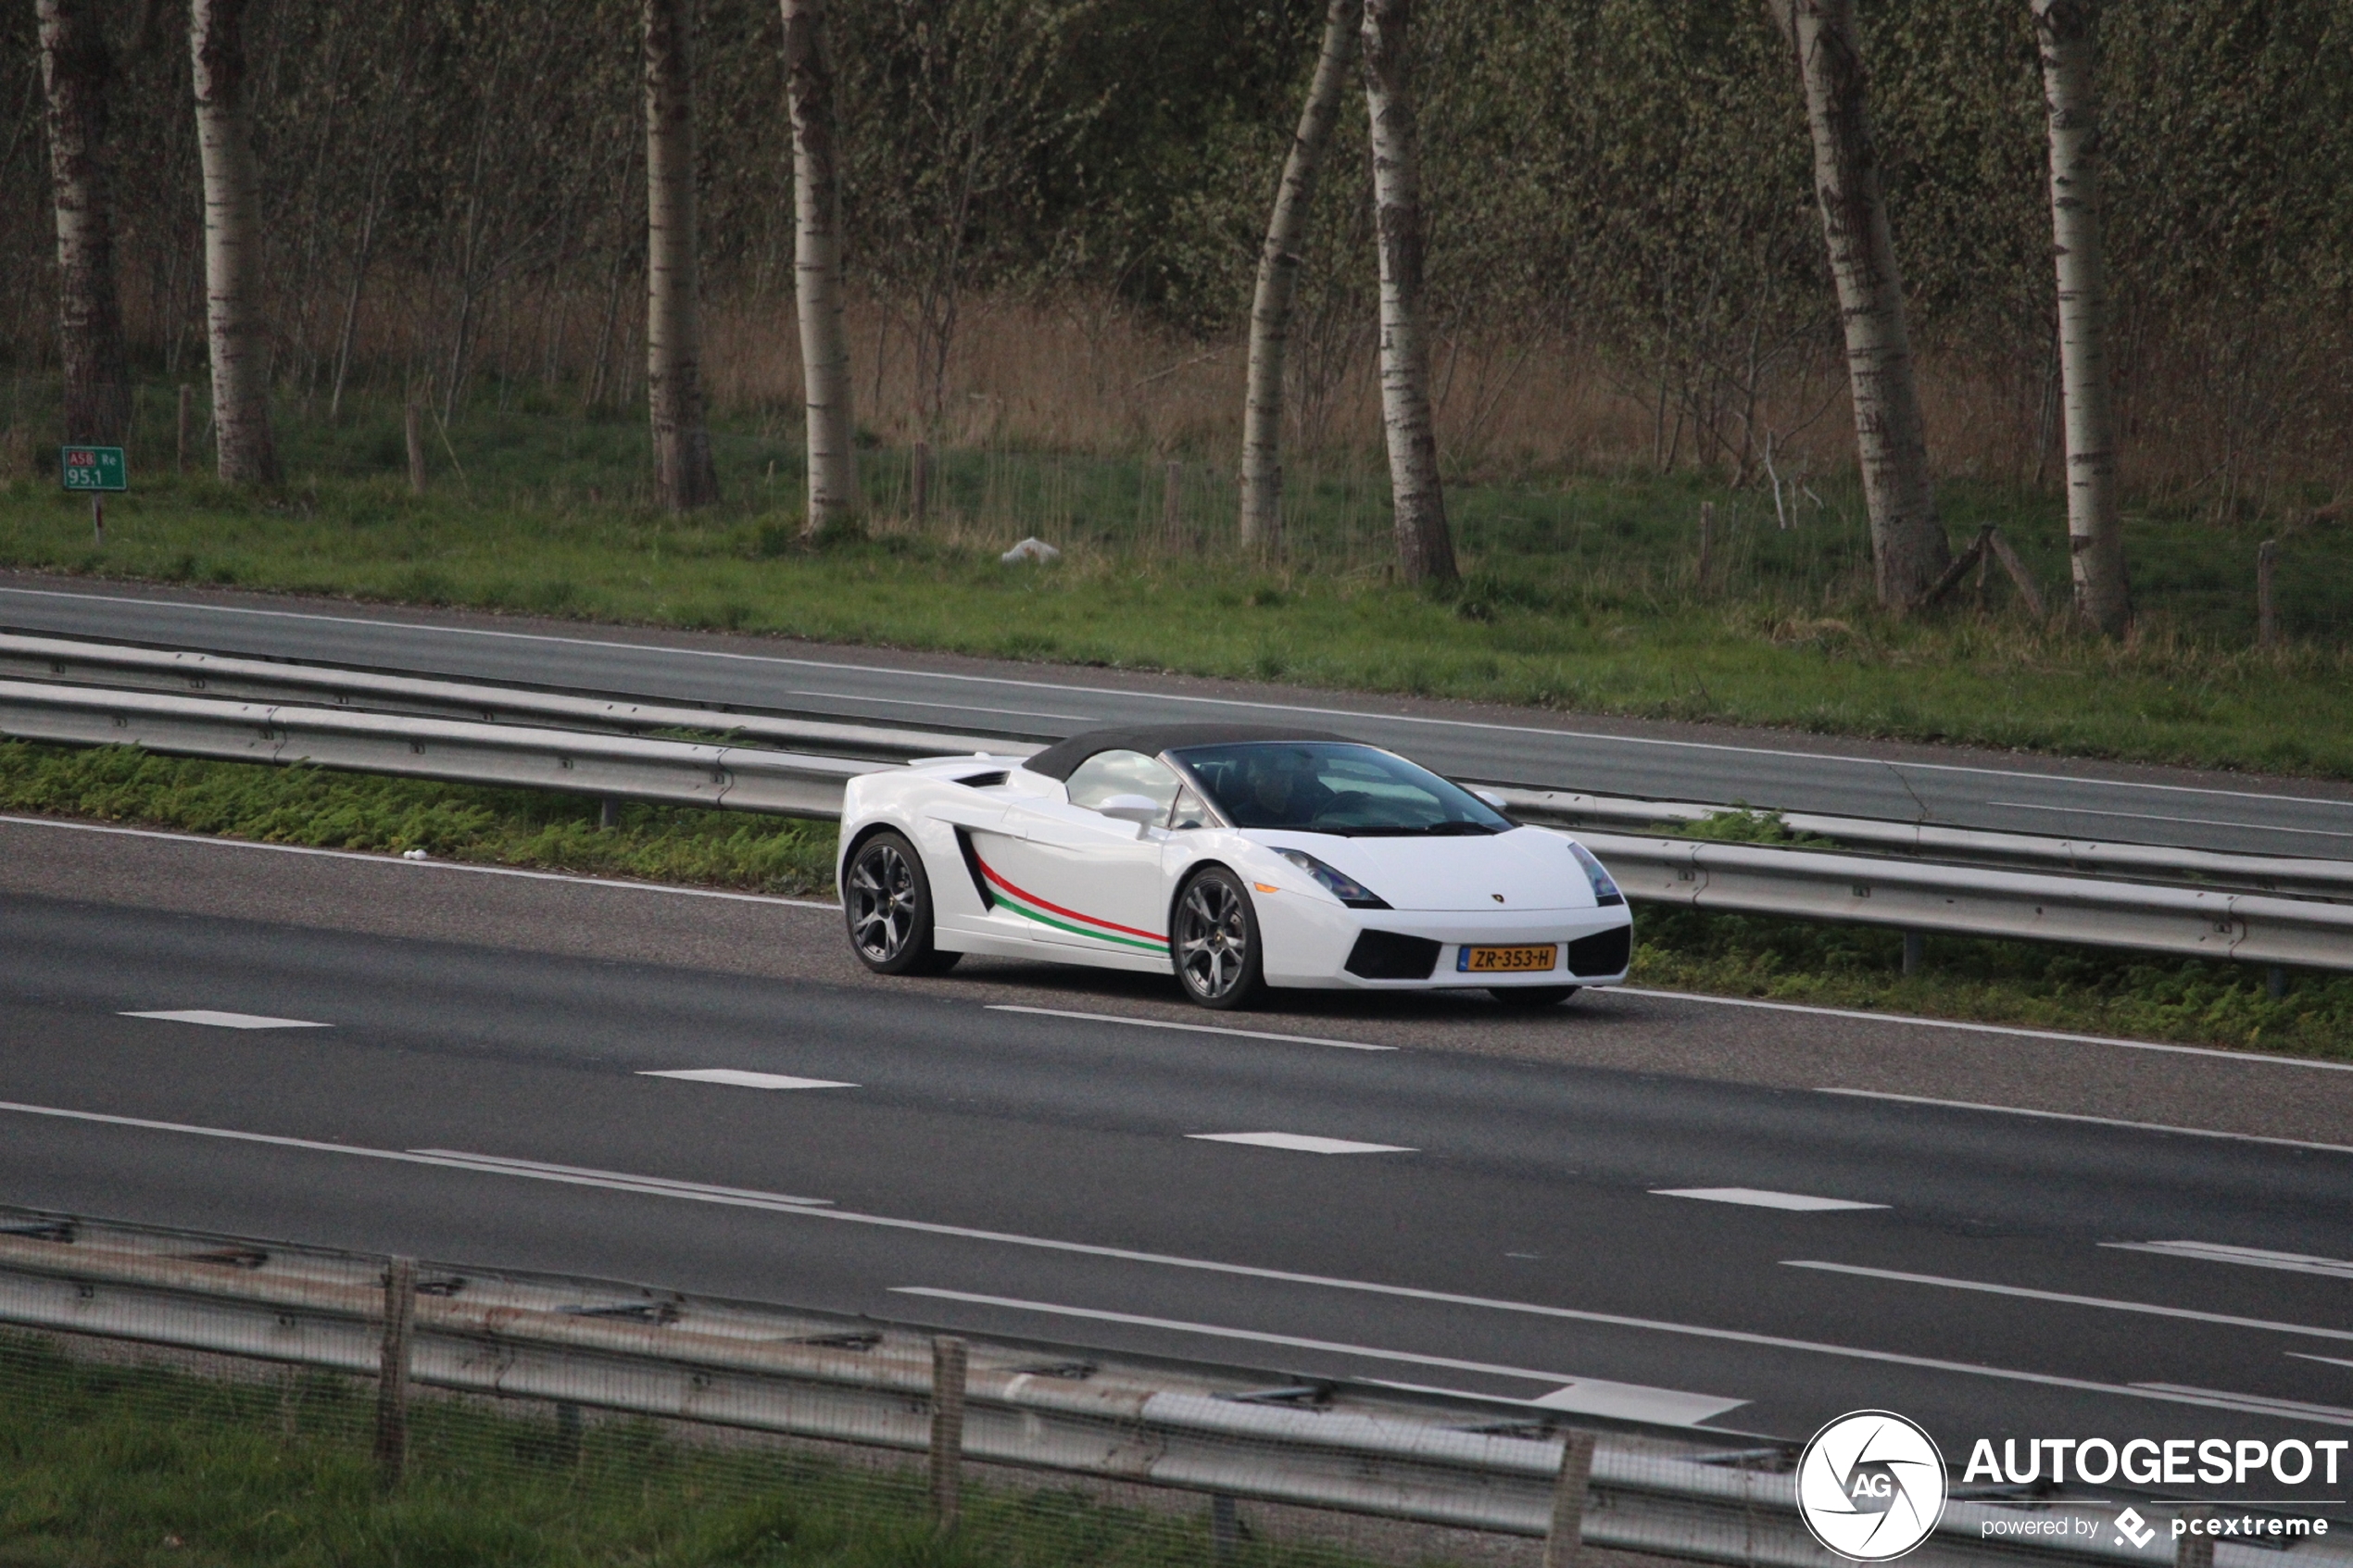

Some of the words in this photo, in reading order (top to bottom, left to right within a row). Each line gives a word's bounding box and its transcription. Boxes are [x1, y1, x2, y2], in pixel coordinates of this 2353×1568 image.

[70, 453, 94, 465] A58
[102, 453, 117, 466] Re
[1475, 949, 1549, 968] ZR-353-H
